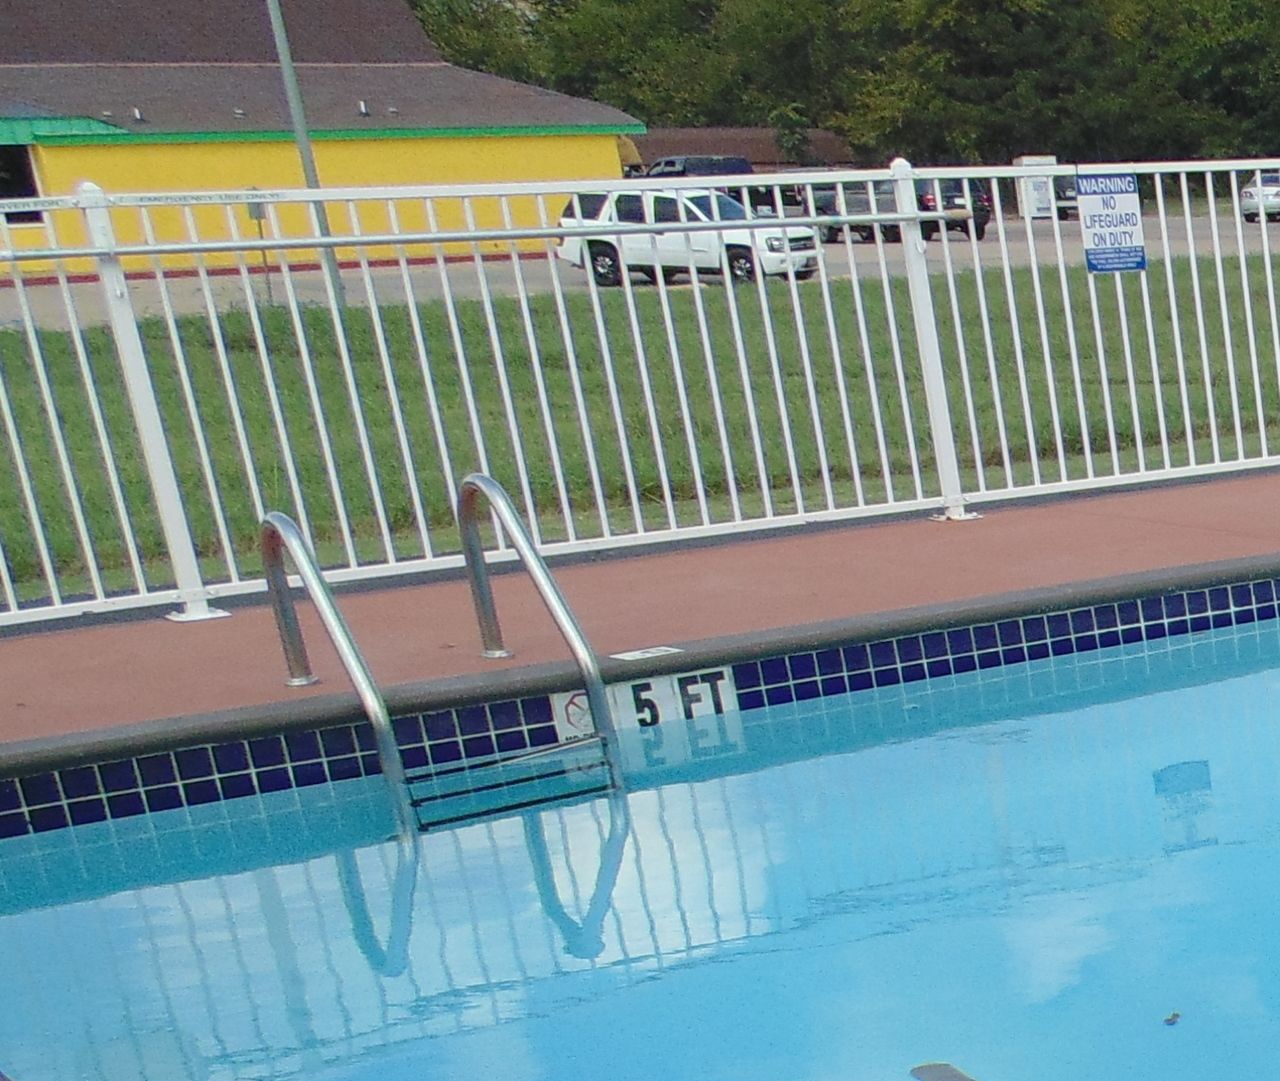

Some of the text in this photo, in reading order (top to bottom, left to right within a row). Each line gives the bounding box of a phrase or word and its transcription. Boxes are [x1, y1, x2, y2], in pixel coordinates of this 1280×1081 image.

[1078, 177, 1134, 193] WARNING
[1101, 196, 1117, 210] NO
[1084, 213, 1138, 229] LIFEGUARD
[1093, 231, 1134, 247] ON DUTY
[631, 670, 725, 727] 5 FT
